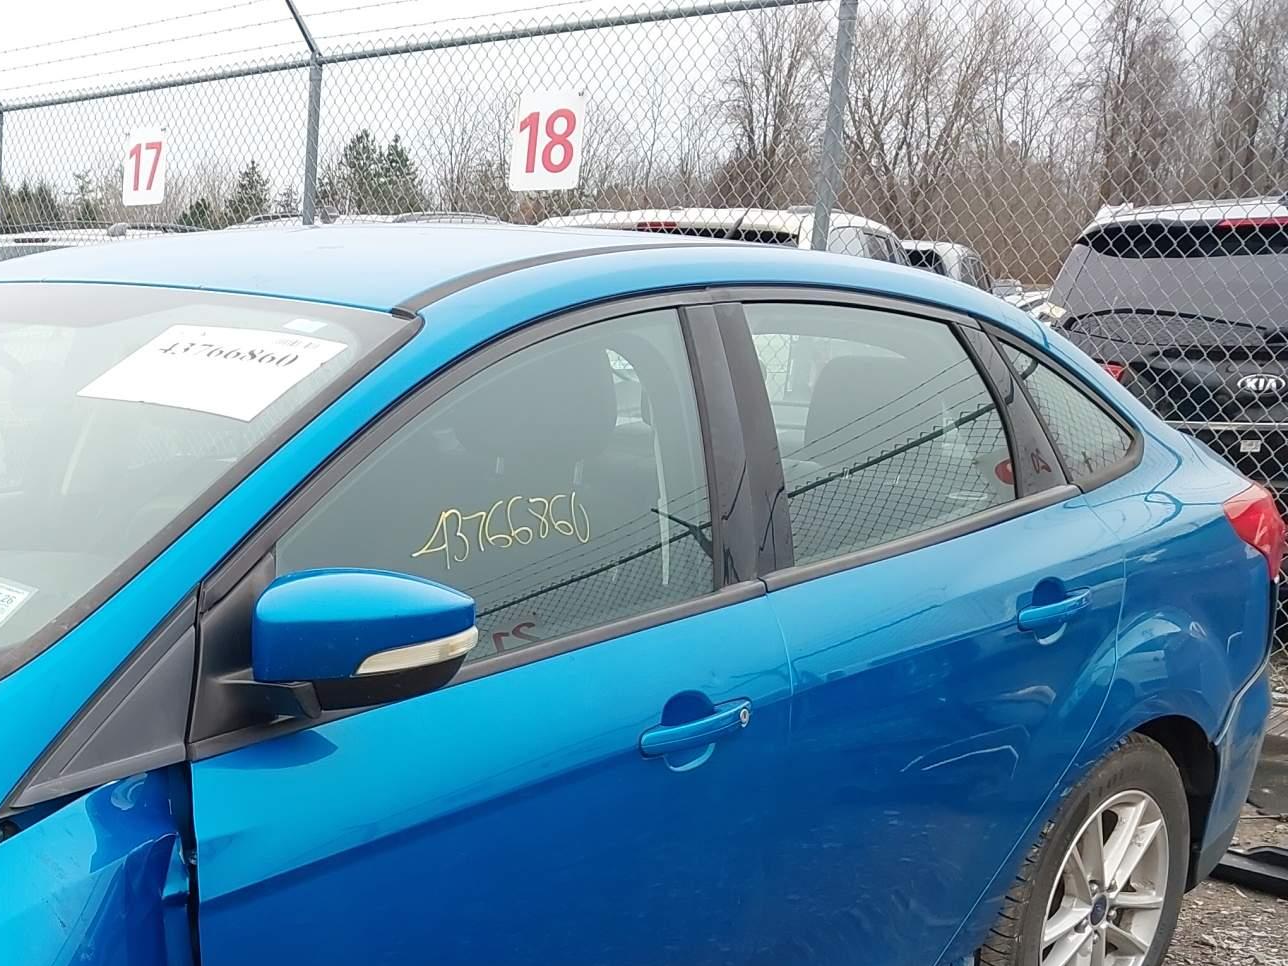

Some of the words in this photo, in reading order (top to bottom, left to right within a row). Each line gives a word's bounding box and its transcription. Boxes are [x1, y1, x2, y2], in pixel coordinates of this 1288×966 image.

[519, 108, 576, 173] 18
[129, 141, 162, 191] 17
[160, 342, 299, 367] 43766860
[1245, 378, 1277, 390] KIA
[411, 491, 590, 570] 43766860
